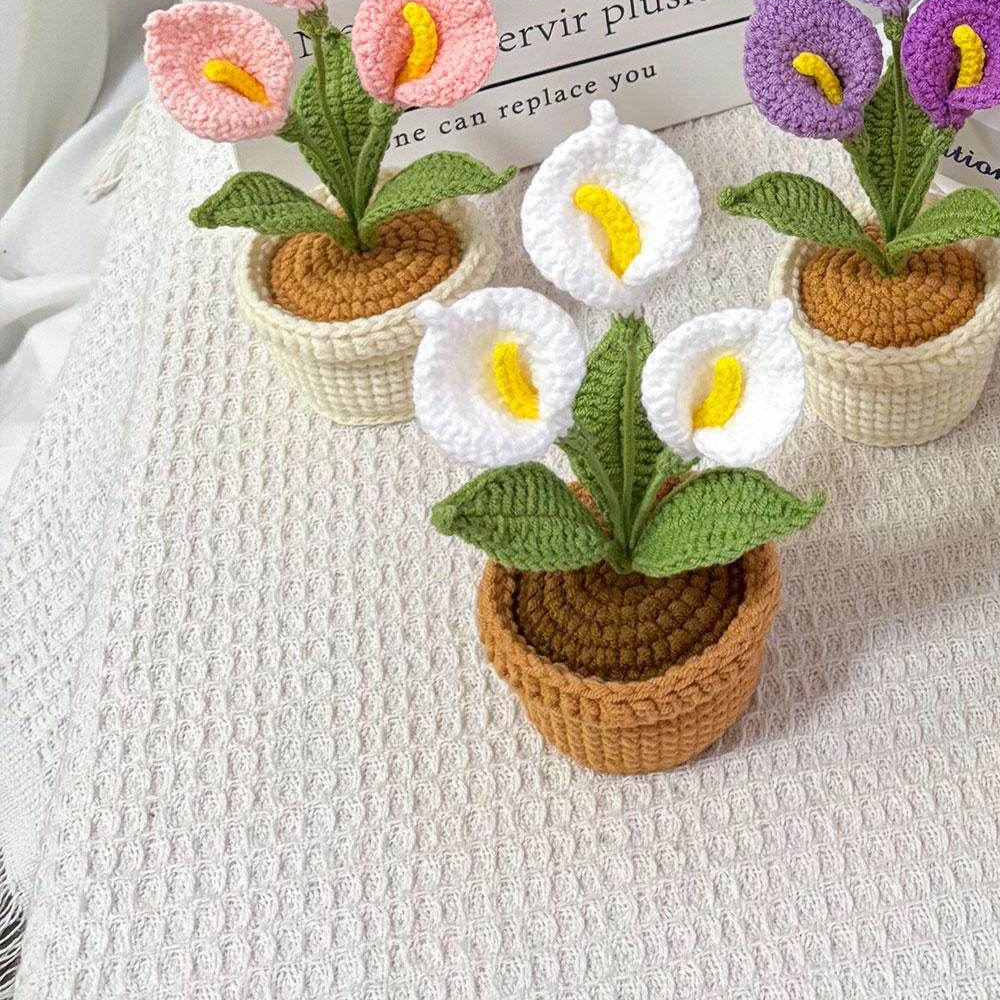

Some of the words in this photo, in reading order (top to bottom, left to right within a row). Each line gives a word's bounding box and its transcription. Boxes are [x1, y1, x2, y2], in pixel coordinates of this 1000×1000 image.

[498, 8, 588, 52] ervir
[387, 128, 427, 149] ne
[439, 111, 486, 135] can
[498, 80, 598, 119] replace
[608, 65, 657, 93] you
